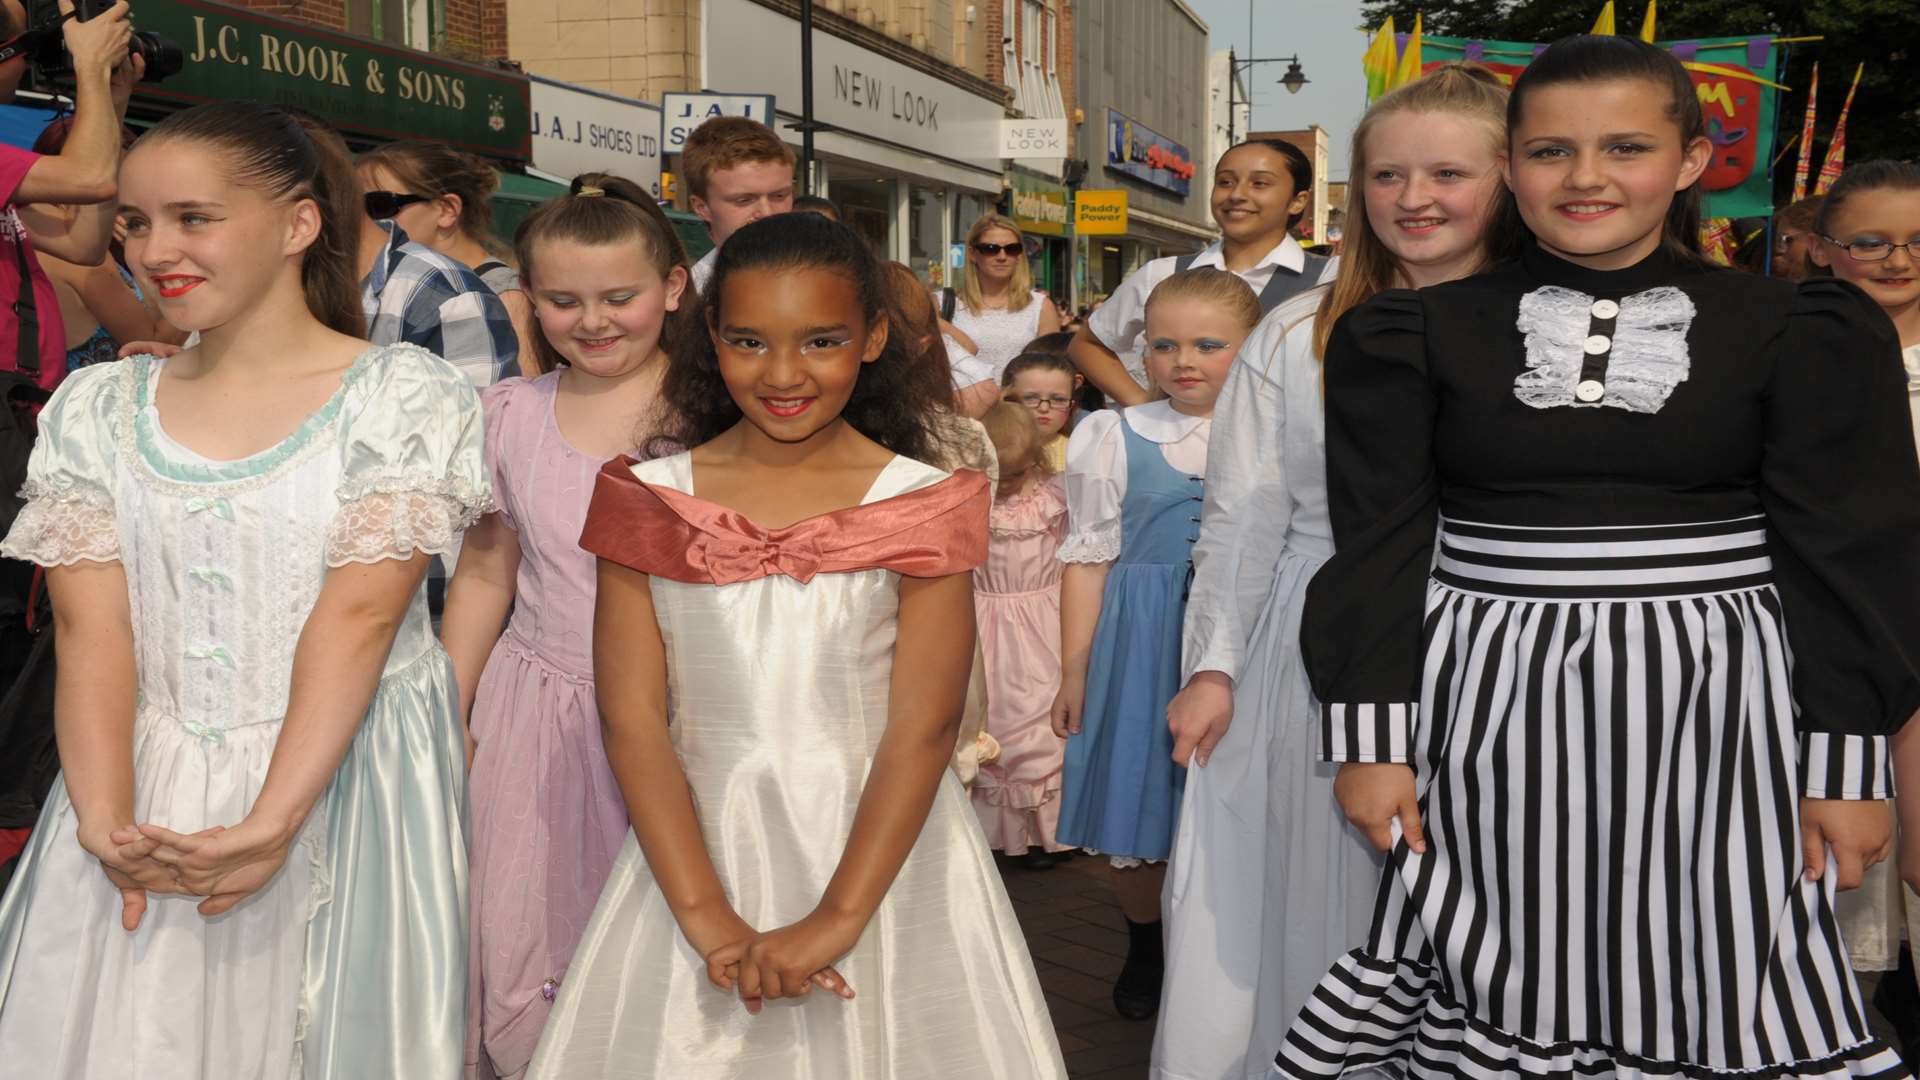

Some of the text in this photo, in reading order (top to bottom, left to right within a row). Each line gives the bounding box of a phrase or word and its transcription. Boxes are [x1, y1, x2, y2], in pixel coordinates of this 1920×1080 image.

[190, 16, 248, 66] J.C.
[260, 34, 351, 87] ROOK
[366, 59, 385, 94] &
[399, 66, 466, 110] SONS
[834, 64, 938, 131] NEW LOOK
[531, 111, 582, 144] J.A.J
[590, 123, 633, 155] SHOES
[637, 134, 656, 158] LTD
[1011, 128, 1057, 139] NEW
[1007, 139, 1059, 150] LOOK
[1080, 204, 1120, 214] Paddy
[1080, 213, 1120, 221] Power
